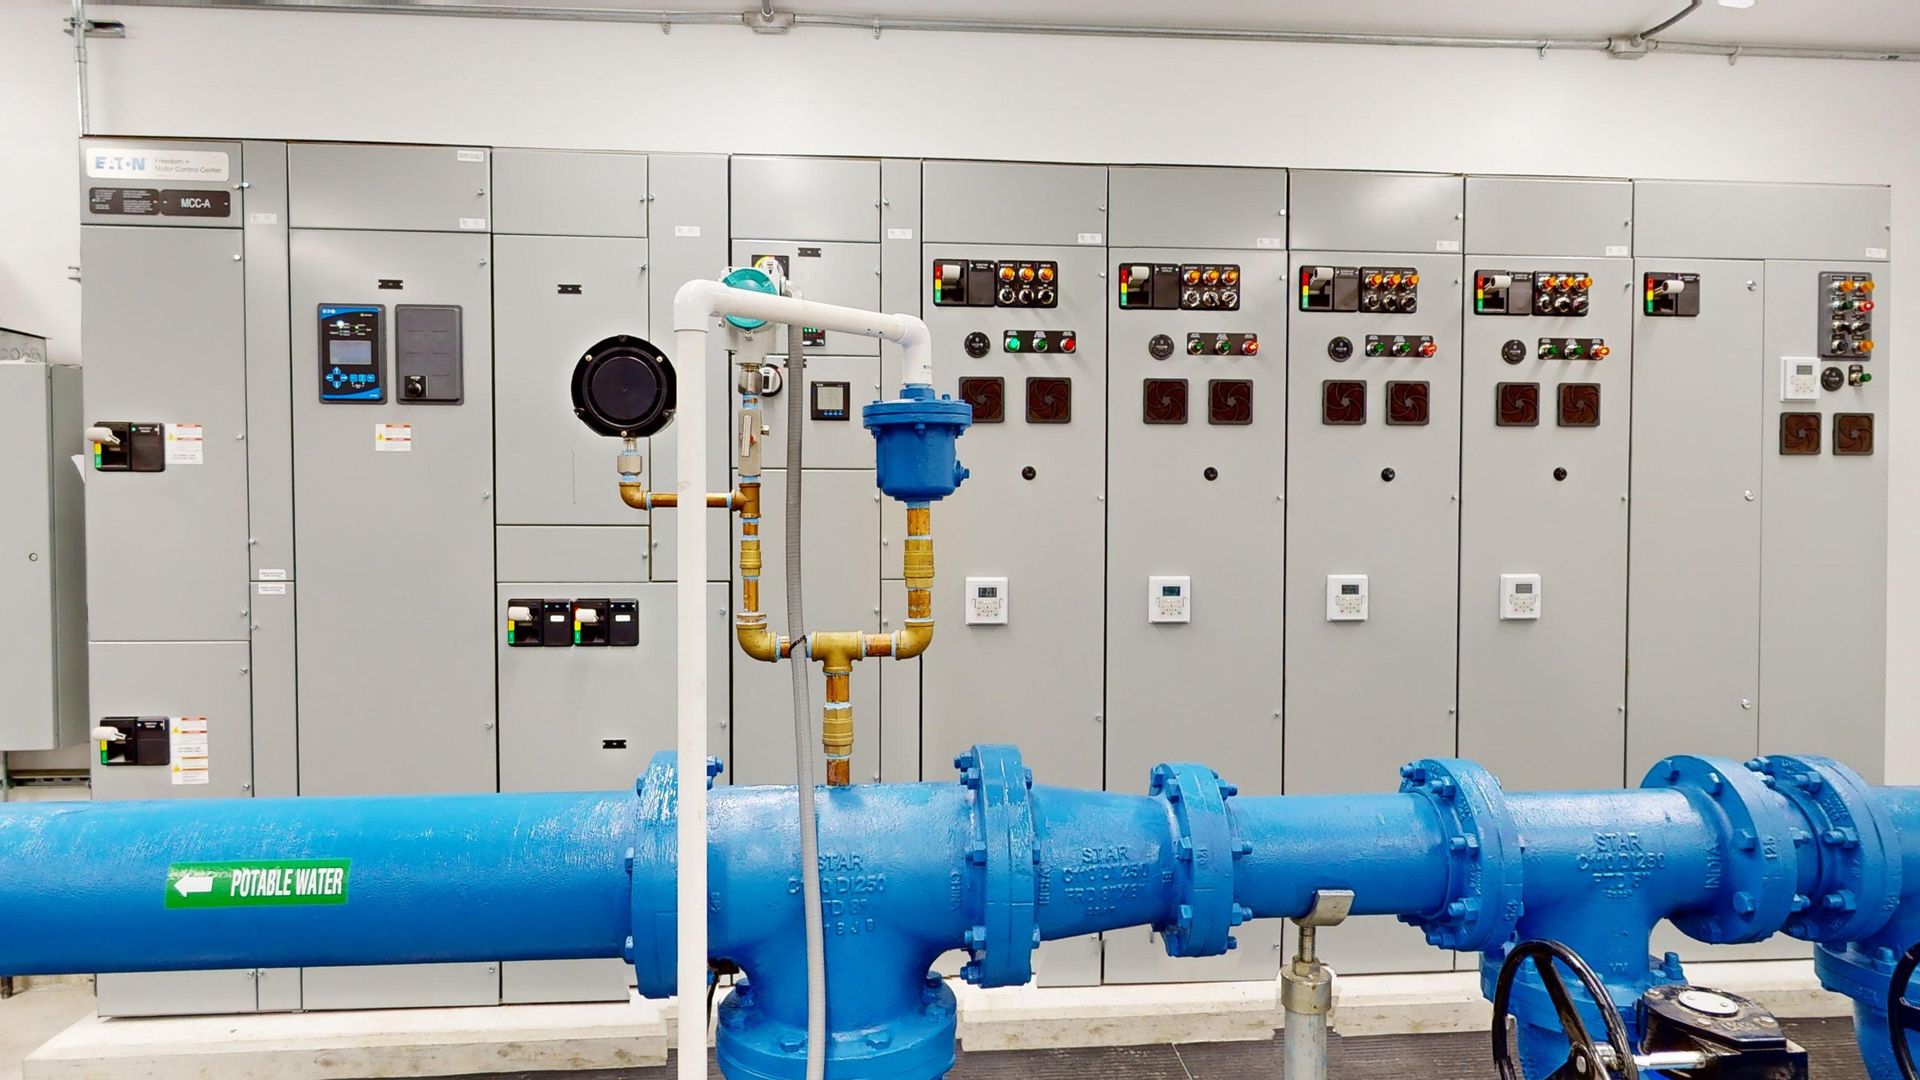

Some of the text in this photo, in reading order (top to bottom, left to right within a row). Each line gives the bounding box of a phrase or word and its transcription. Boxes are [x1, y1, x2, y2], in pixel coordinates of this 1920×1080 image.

[180, 197, 211, 209] MCC-A
[1594, 832, 1642, 851] STAR
[818, 853, 864, 872] STAR
[1082, 847, 1129, 864] STAR
[230, 867, 344, 897] POTABLE WATER
